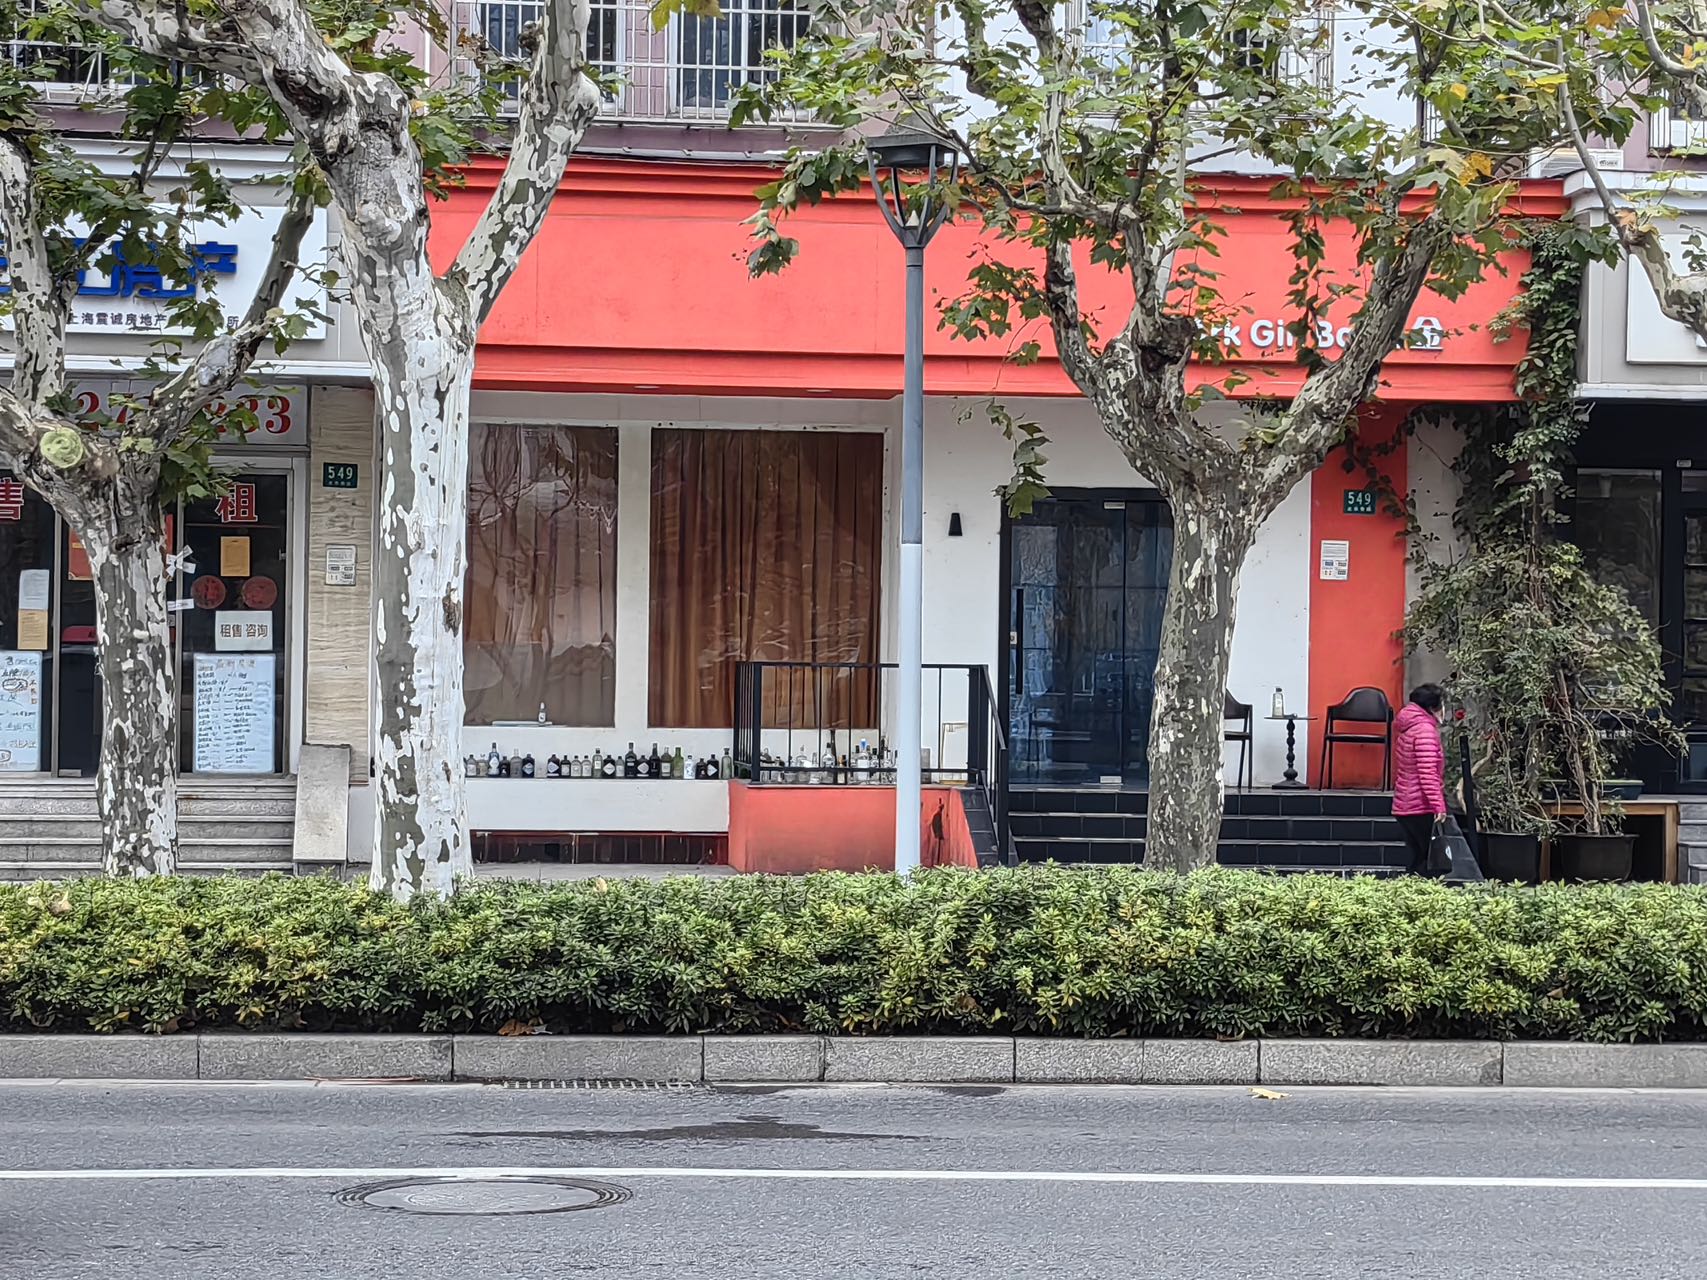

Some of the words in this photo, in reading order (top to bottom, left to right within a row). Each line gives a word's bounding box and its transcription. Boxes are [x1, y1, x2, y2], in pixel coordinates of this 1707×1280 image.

[327, 465, 353, 480] 549
[215, 483, 258, 522] 租
[1347, 491, 1372, 506] 549
